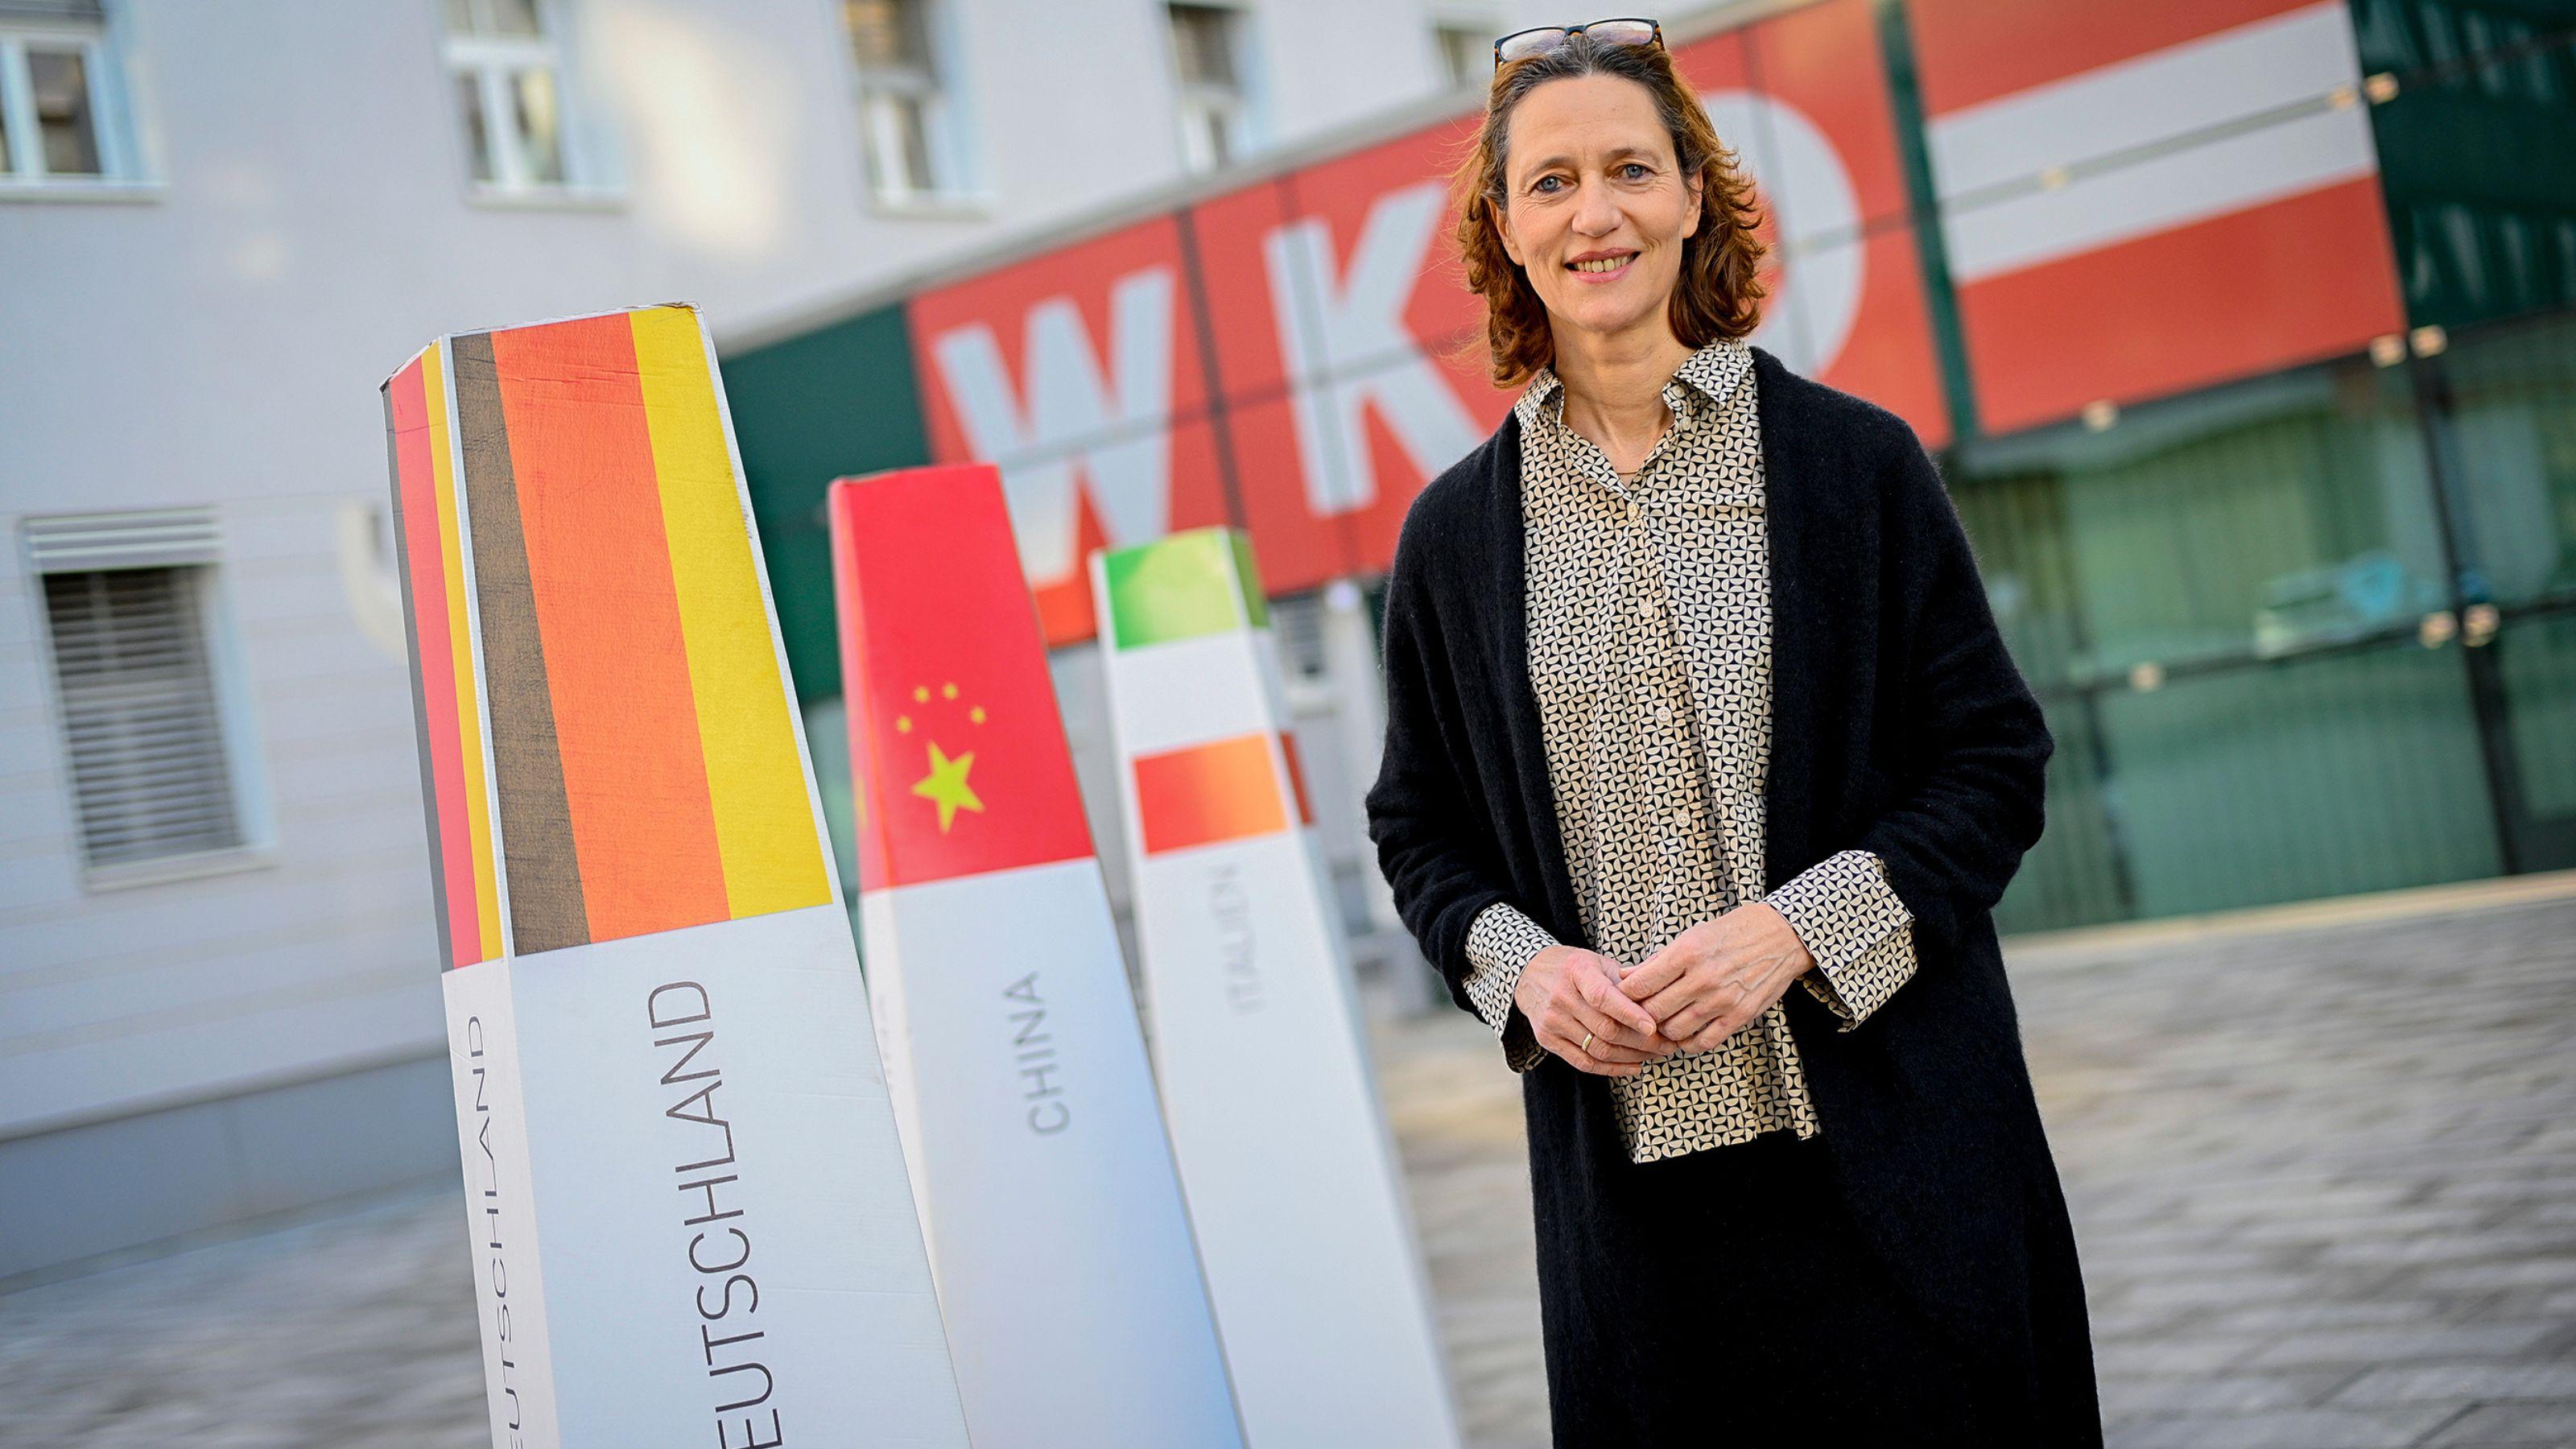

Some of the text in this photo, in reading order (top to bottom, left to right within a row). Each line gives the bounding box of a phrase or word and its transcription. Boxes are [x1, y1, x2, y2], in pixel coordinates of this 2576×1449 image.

[1002, 970, 1071, 1136] CHINA
[1209, 862, 1267, 1015] ITALIEN
[468, 1015, 523, 1449] UTSCHLAND
[647, 980, 783, 1449] EUTSCHLAND
